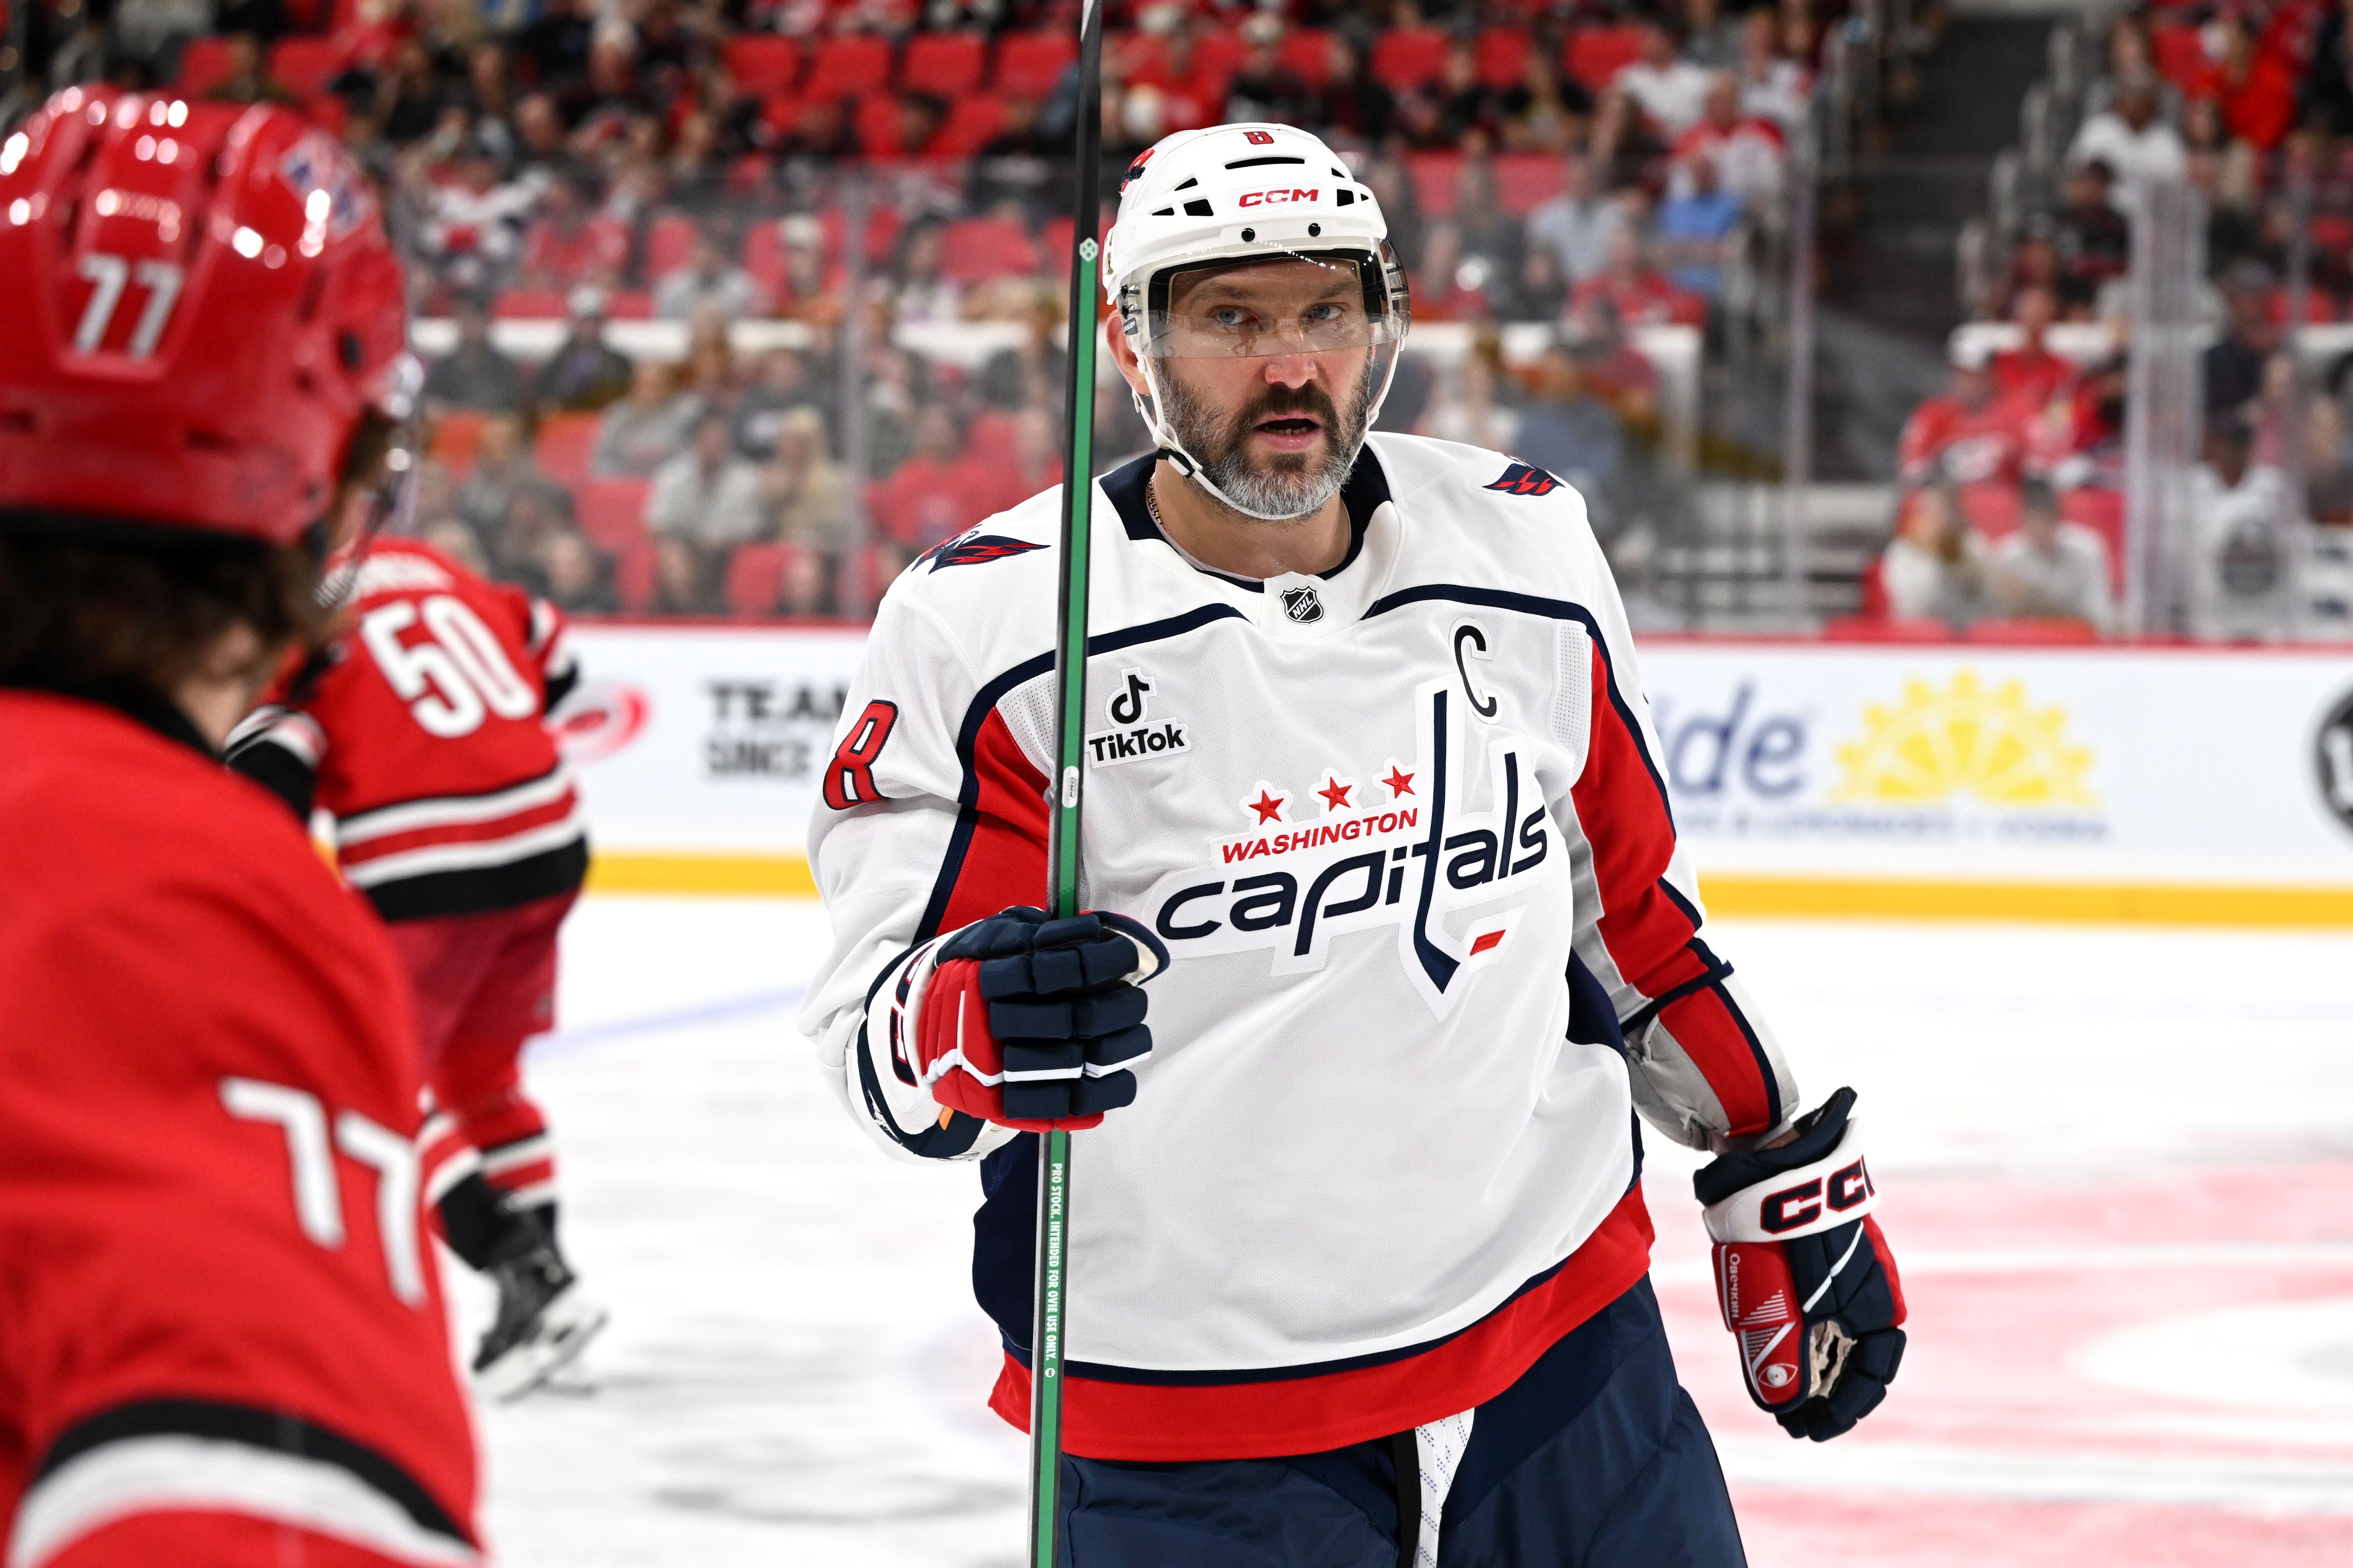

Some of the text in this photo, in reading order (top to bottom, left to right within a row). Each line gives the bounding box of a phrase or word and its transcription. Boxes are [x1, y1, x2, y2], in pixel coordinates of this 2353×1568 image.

[1243, 130, 1274, 145] 8
[1239, 188, 1318, 208] CCM
[71, 252, 184, 362] 77
[1292, 596, 1313, 618] NHL
[359, 593, 538, 739] 50
[1454, 625, 1497, 718] C
[823, 699, 898, 810] 8
[1089, 724, 1185, 761] TikTok
[1156, 689, 1548, 995] capitals
[1222, 808, 1418, 864] WASHINGTON
[218, 1075, 428, 1311] 77
[1760, 1154, 1875, 1235] CC
[1046, 1163, 1062, 1361] PRO STOCK. INTENDED FOR OVIE USE ONLY.
[1729, 1253, 1740, 1318] Овечкин
